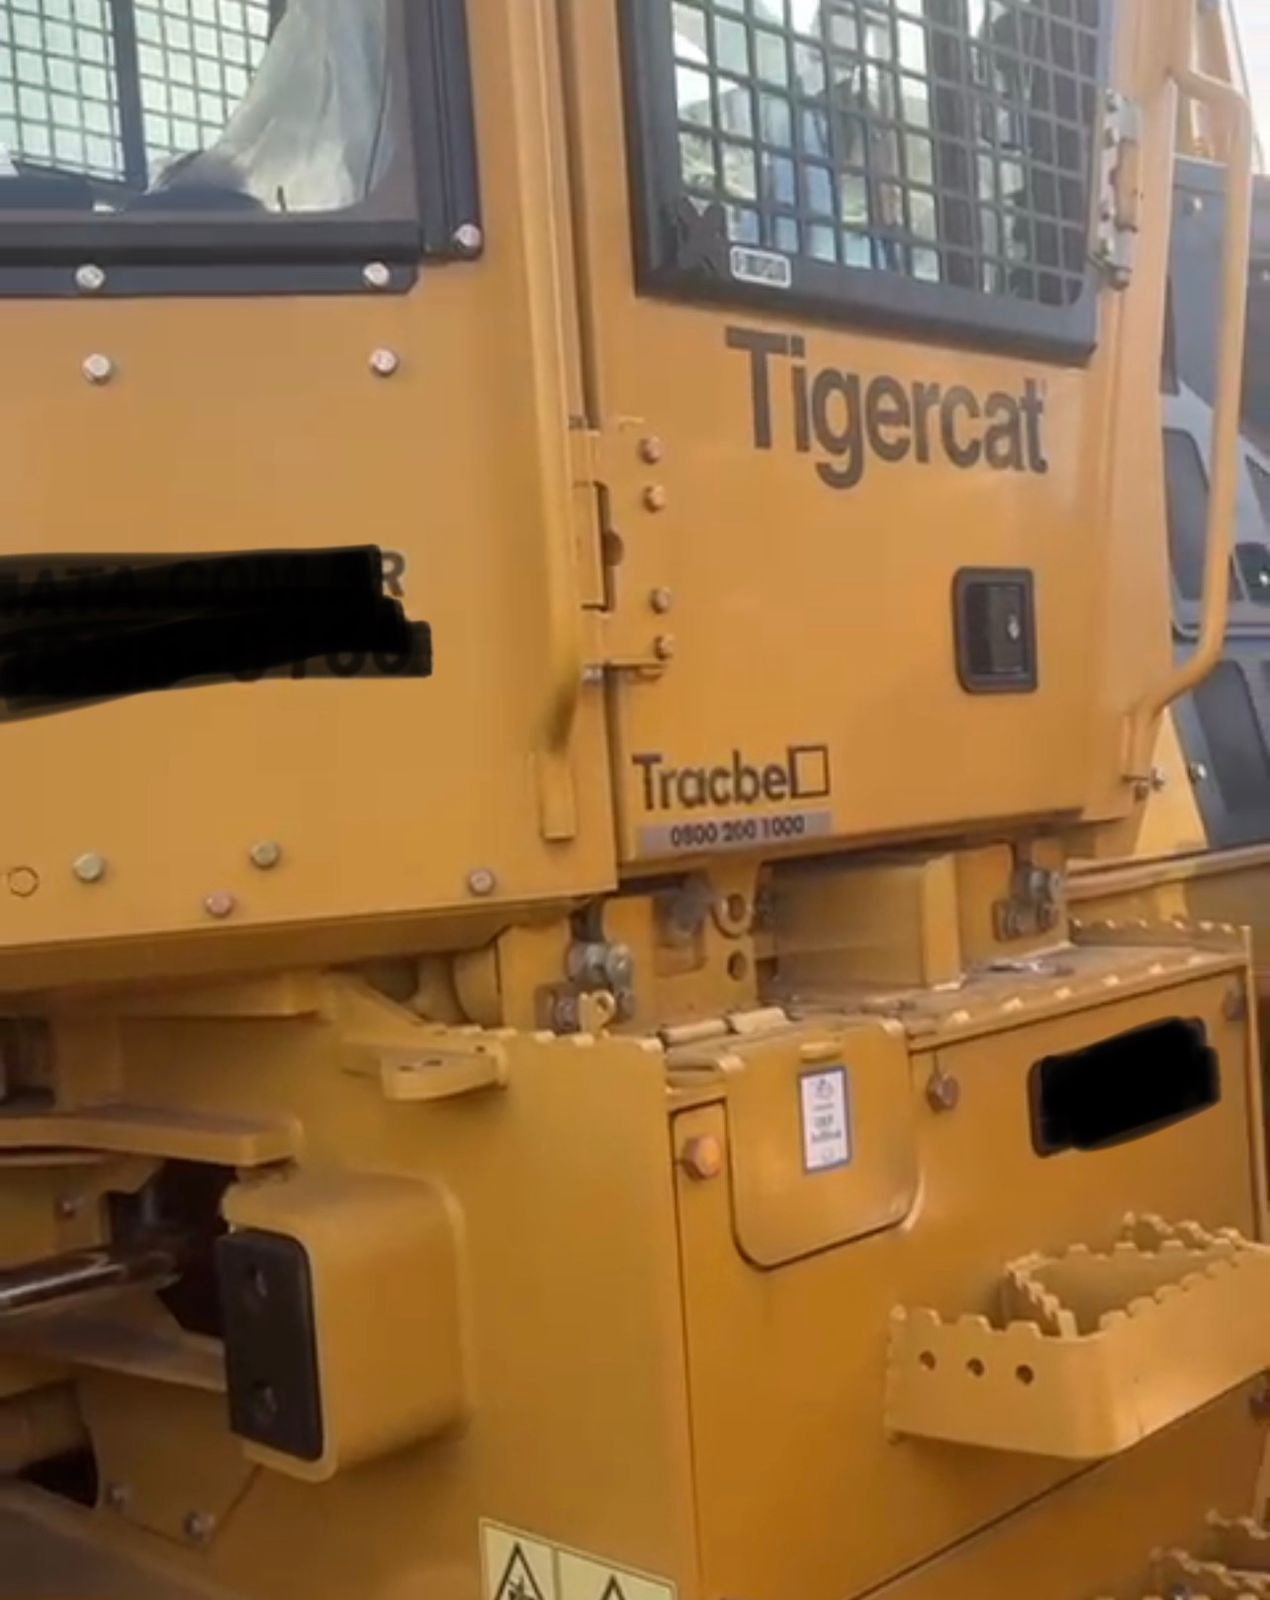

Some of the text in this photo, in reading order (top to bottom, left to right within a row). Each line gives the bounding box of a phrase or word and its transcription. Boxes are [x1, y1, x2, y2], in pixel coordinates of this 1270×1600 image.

[725, 326, 1048, 489] Tigercat
[632, 747, 799, 811] Tracbel
[723, 818, 758, 842] 200
[762, 814, 805, 838] 1000
